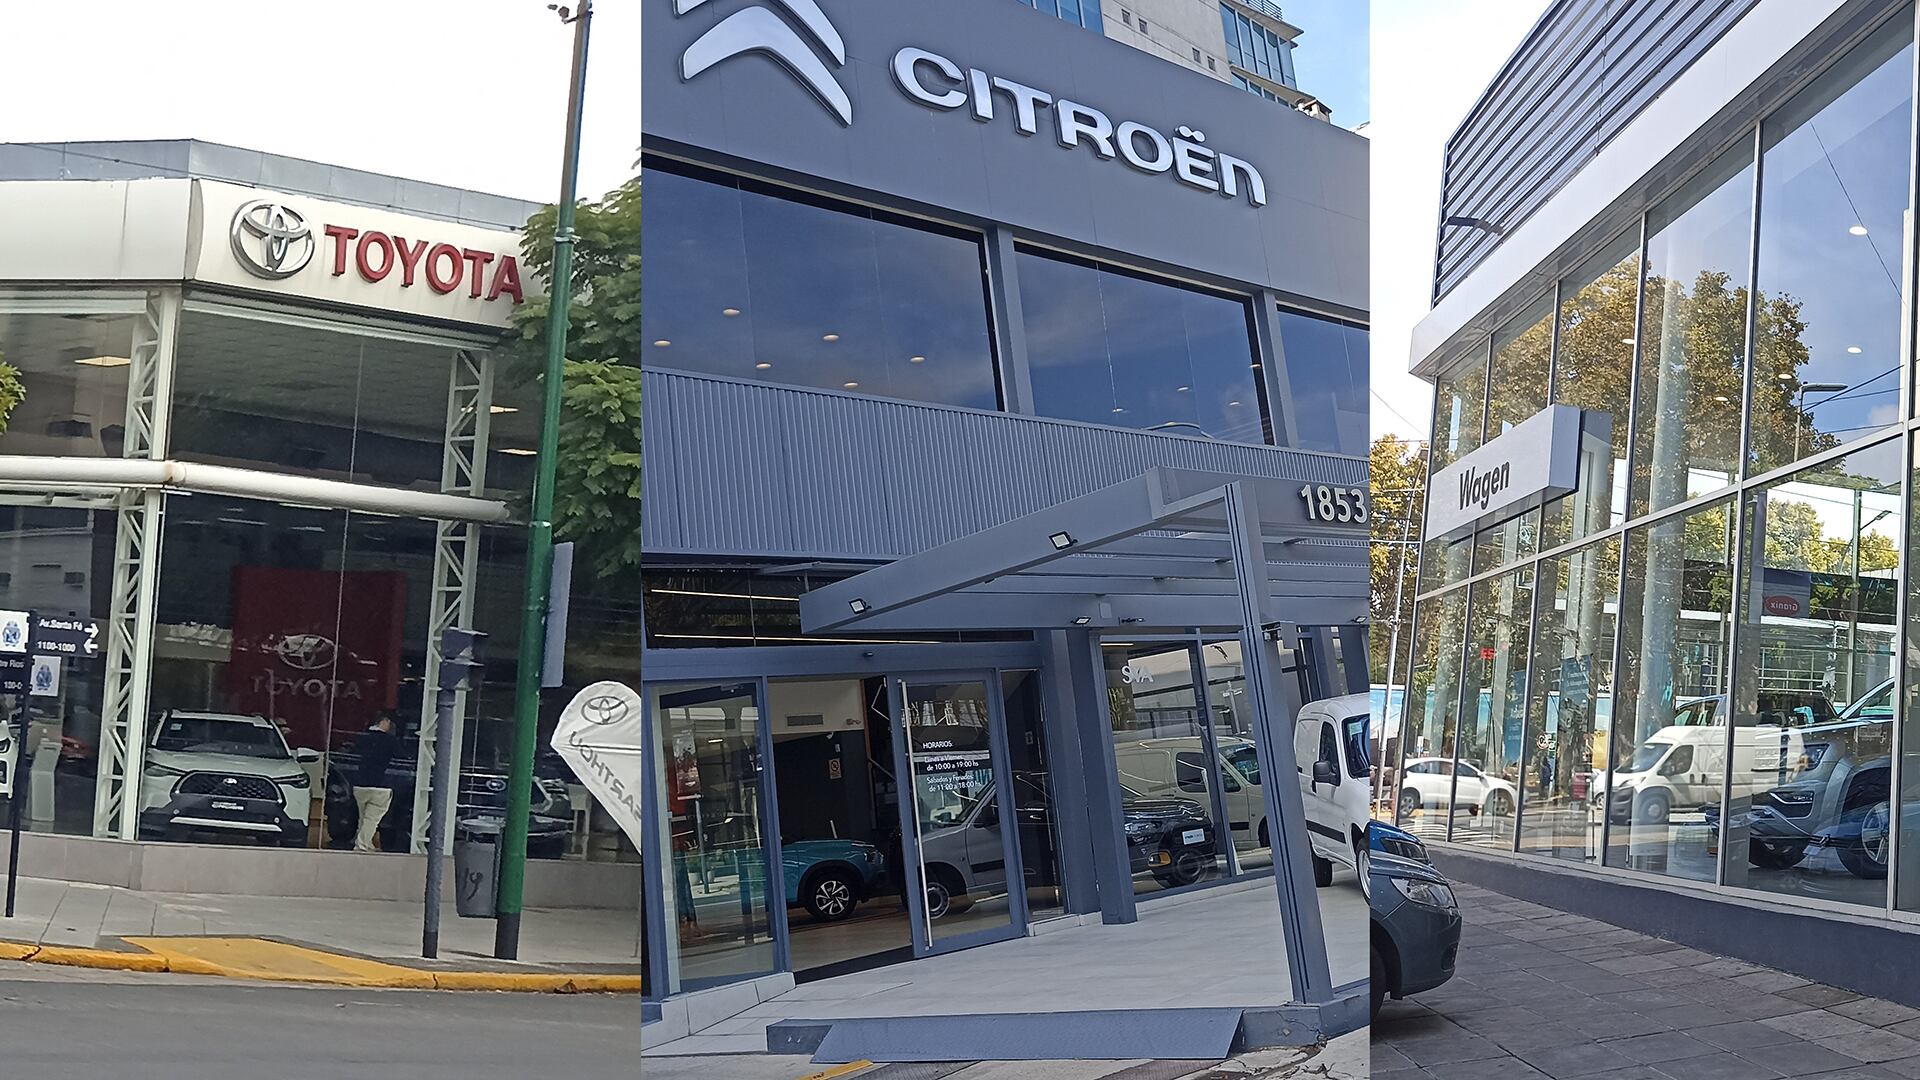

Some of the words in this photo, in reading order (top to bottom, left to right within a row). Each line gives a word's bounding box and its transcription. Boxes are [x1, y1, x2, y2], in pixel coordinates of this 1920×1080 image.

[324, 223, 525, 304] TOYOTA
[1300, 484, 1368, 524] 1853
[1459, 461, 1510, 510] Wagen
[250, 675, 361, 700] TOYOTA
